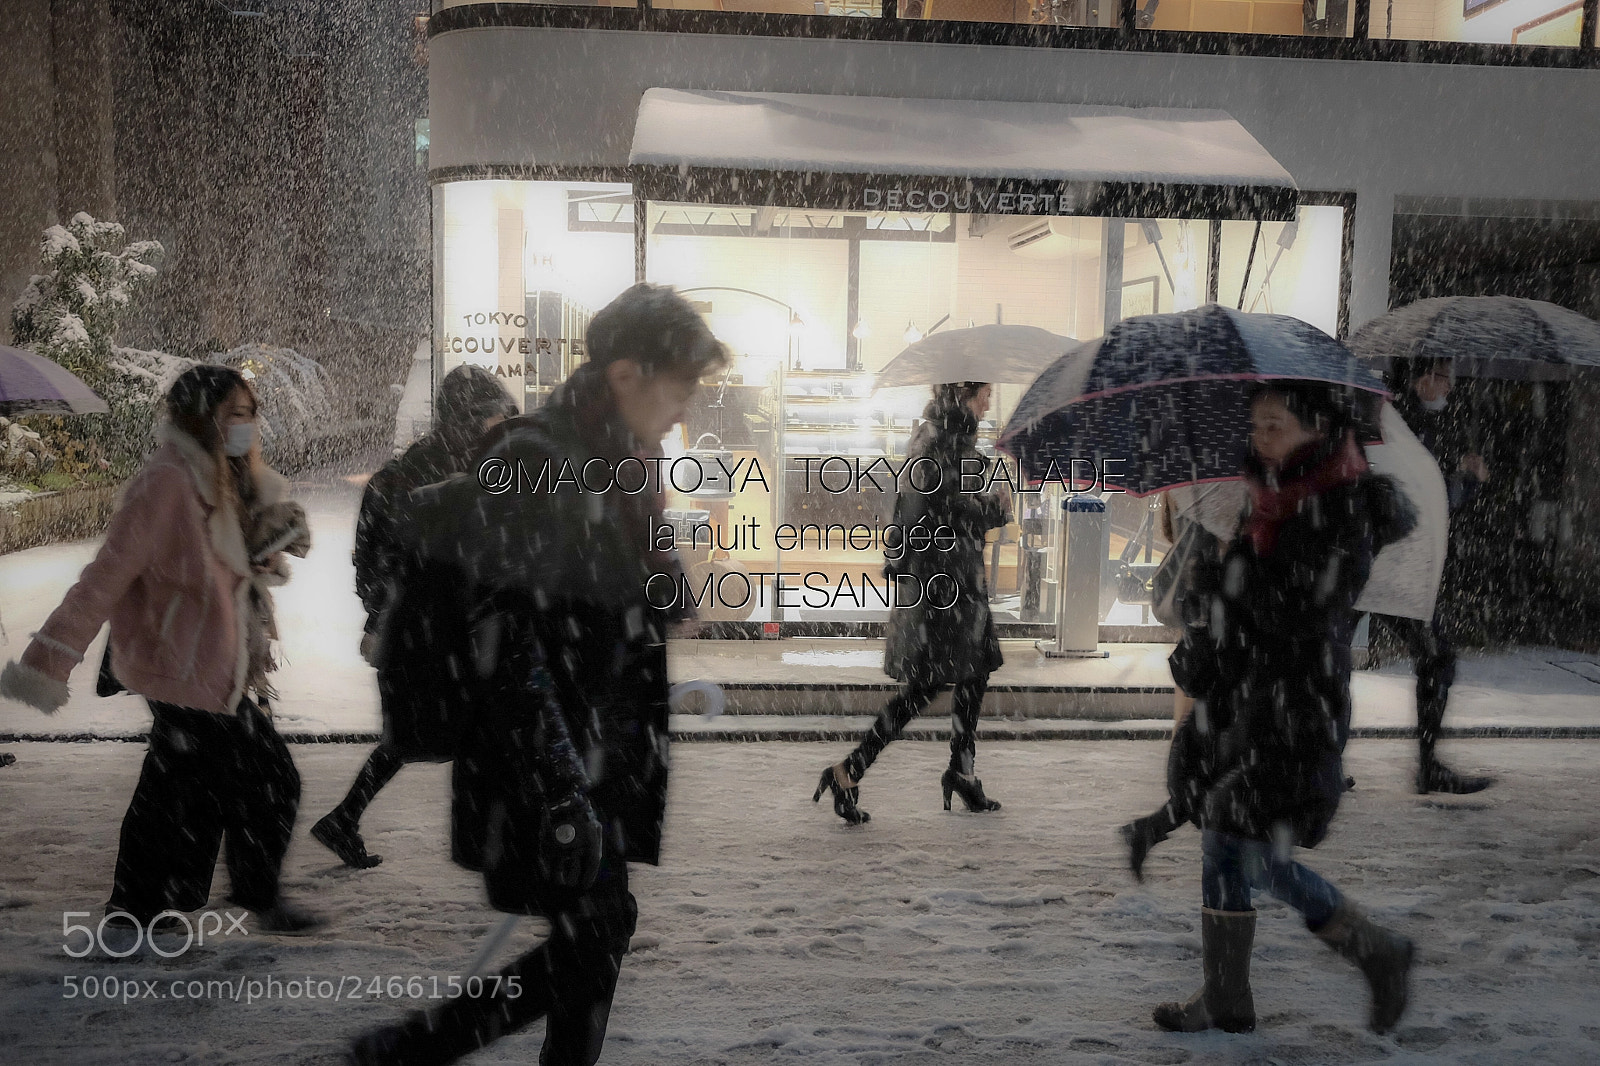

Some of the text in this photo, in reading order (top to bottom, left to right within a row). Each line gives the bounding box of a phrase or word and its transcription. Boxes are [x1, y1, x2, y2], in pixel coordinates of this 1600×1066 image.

[863, 184, 1075, 213] DÉCOUVERTE
[463, 311, 529, 328] TOKYO
[461, 361, 537, 378] YAMA
